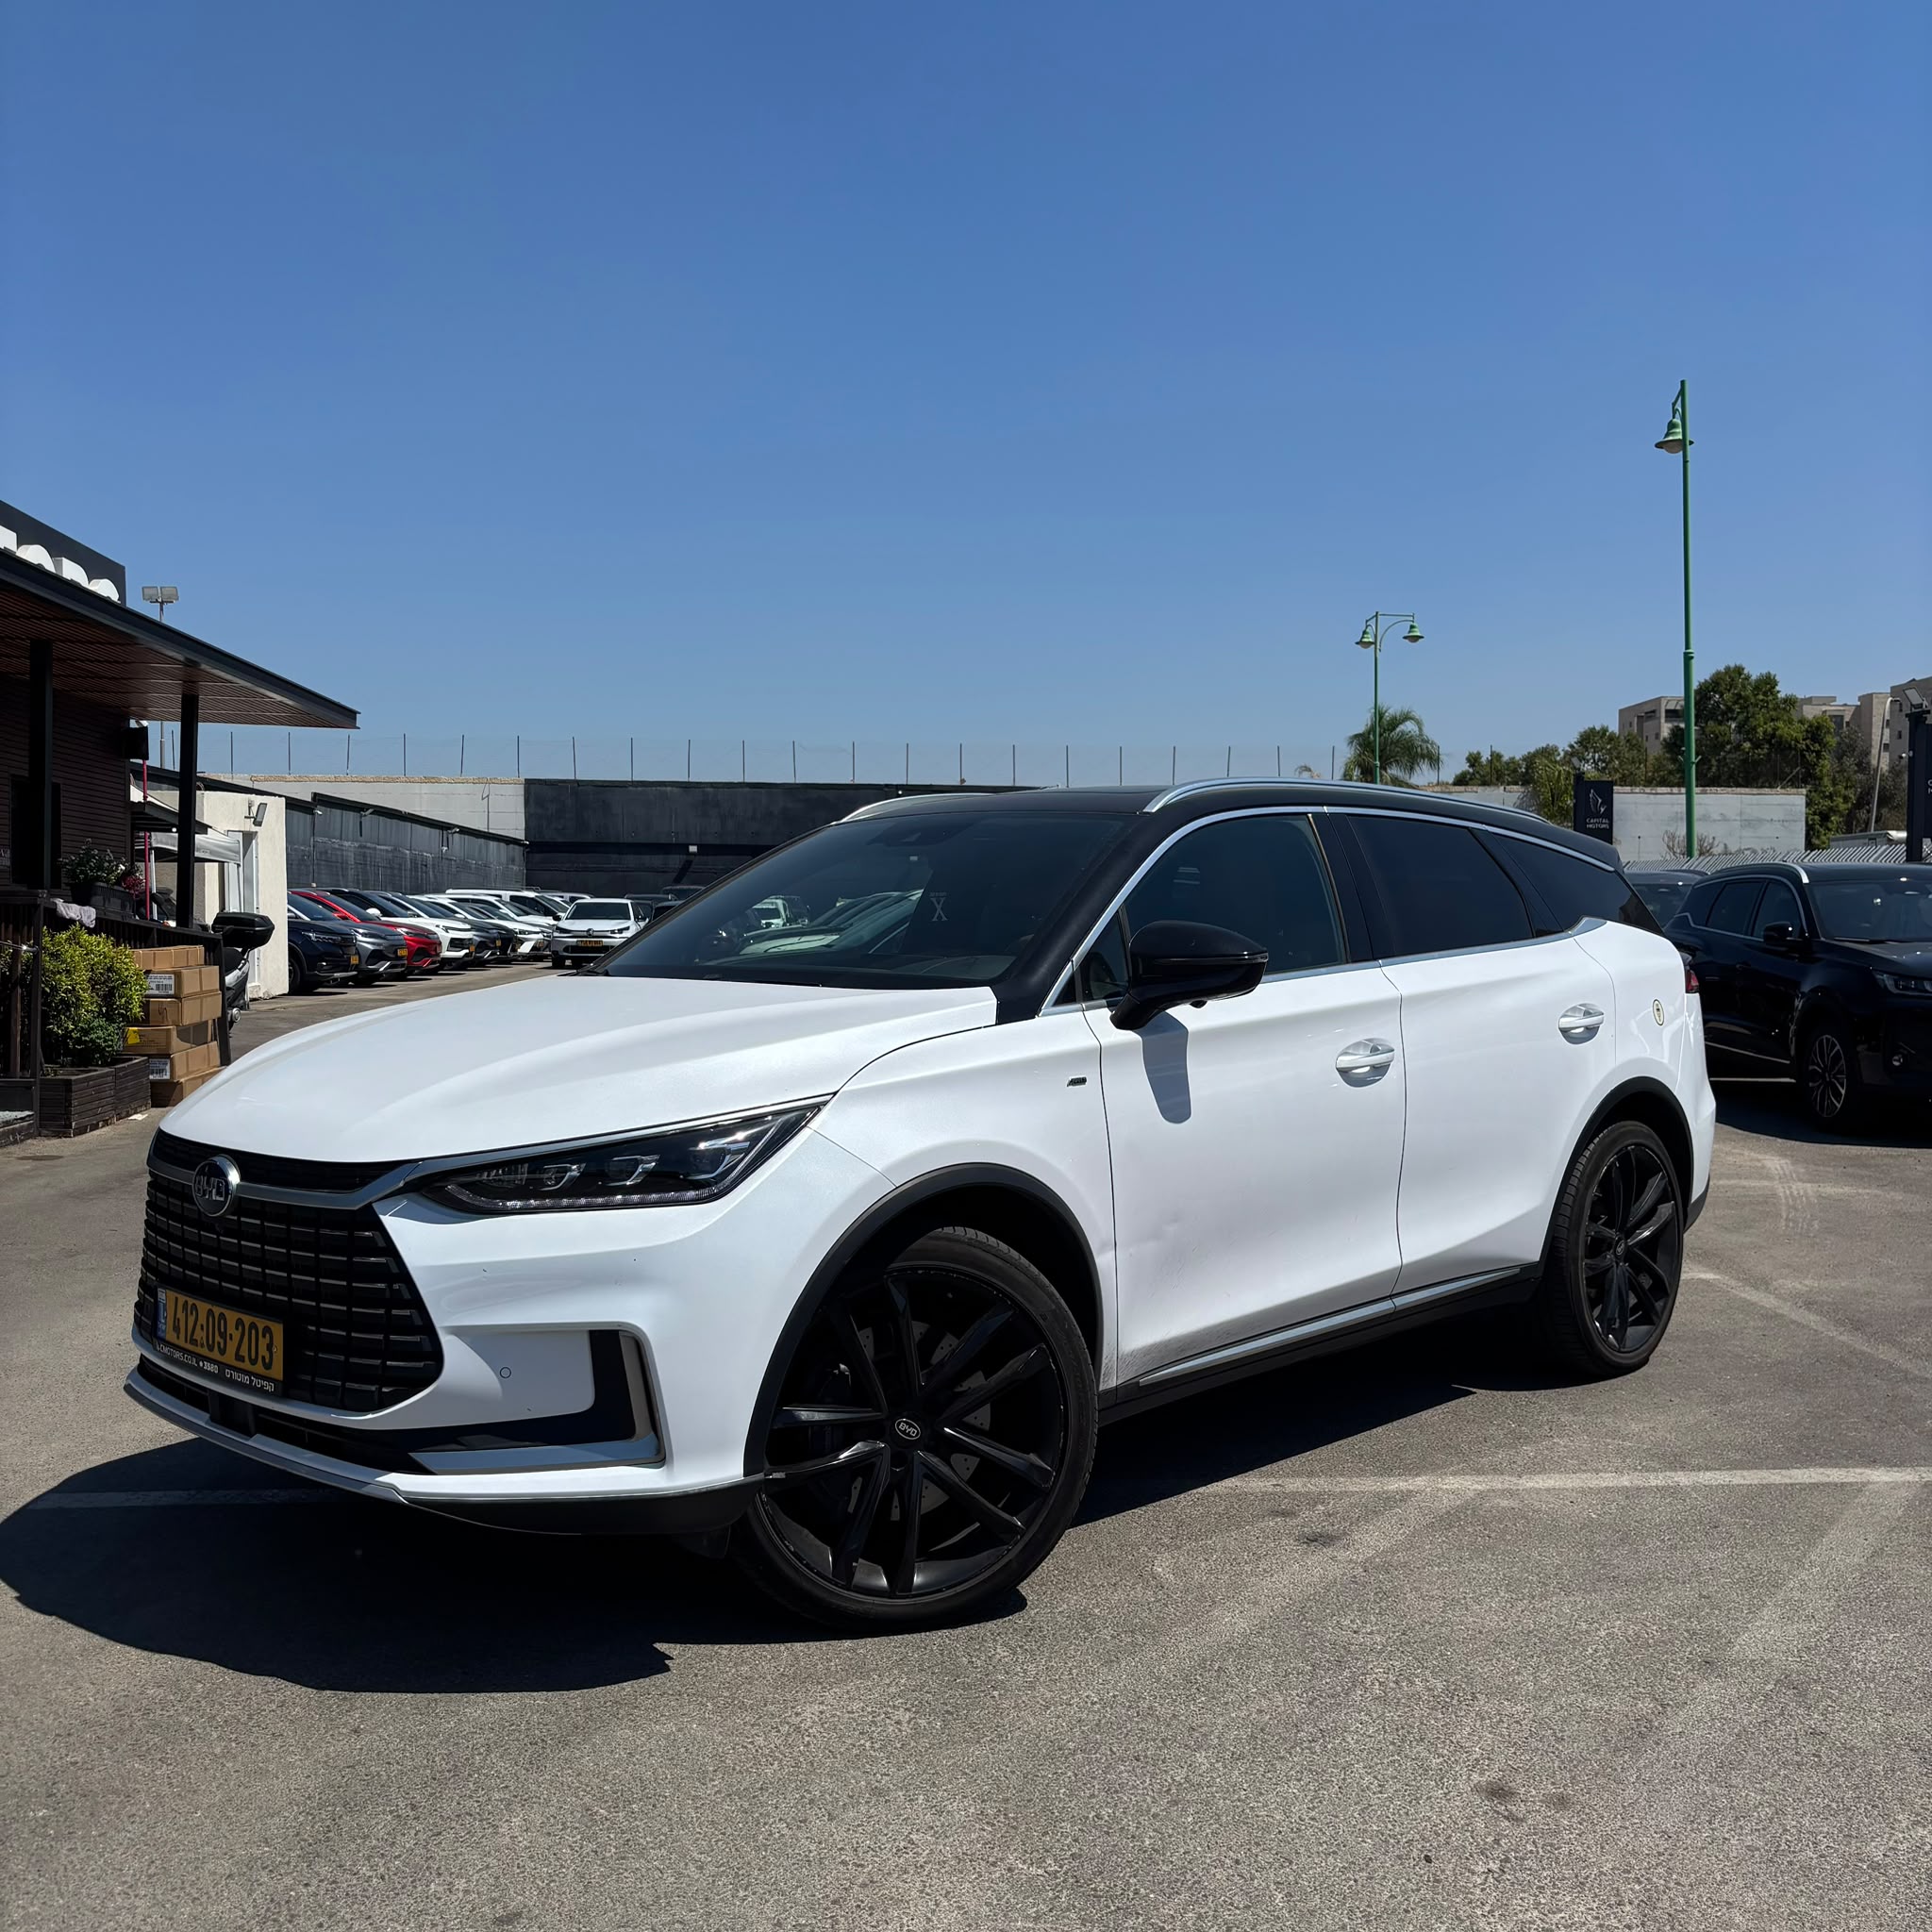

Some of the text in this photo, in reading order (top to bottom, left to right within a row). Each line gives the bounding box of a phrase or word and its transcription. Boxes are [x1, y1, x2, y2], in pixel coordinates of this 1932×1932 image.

[195, 1175, 225, 1201] BYD
[225, 1368, 275, 1392] קפיטל מוטורס
[898, 1422, 918, 1437] BYD
